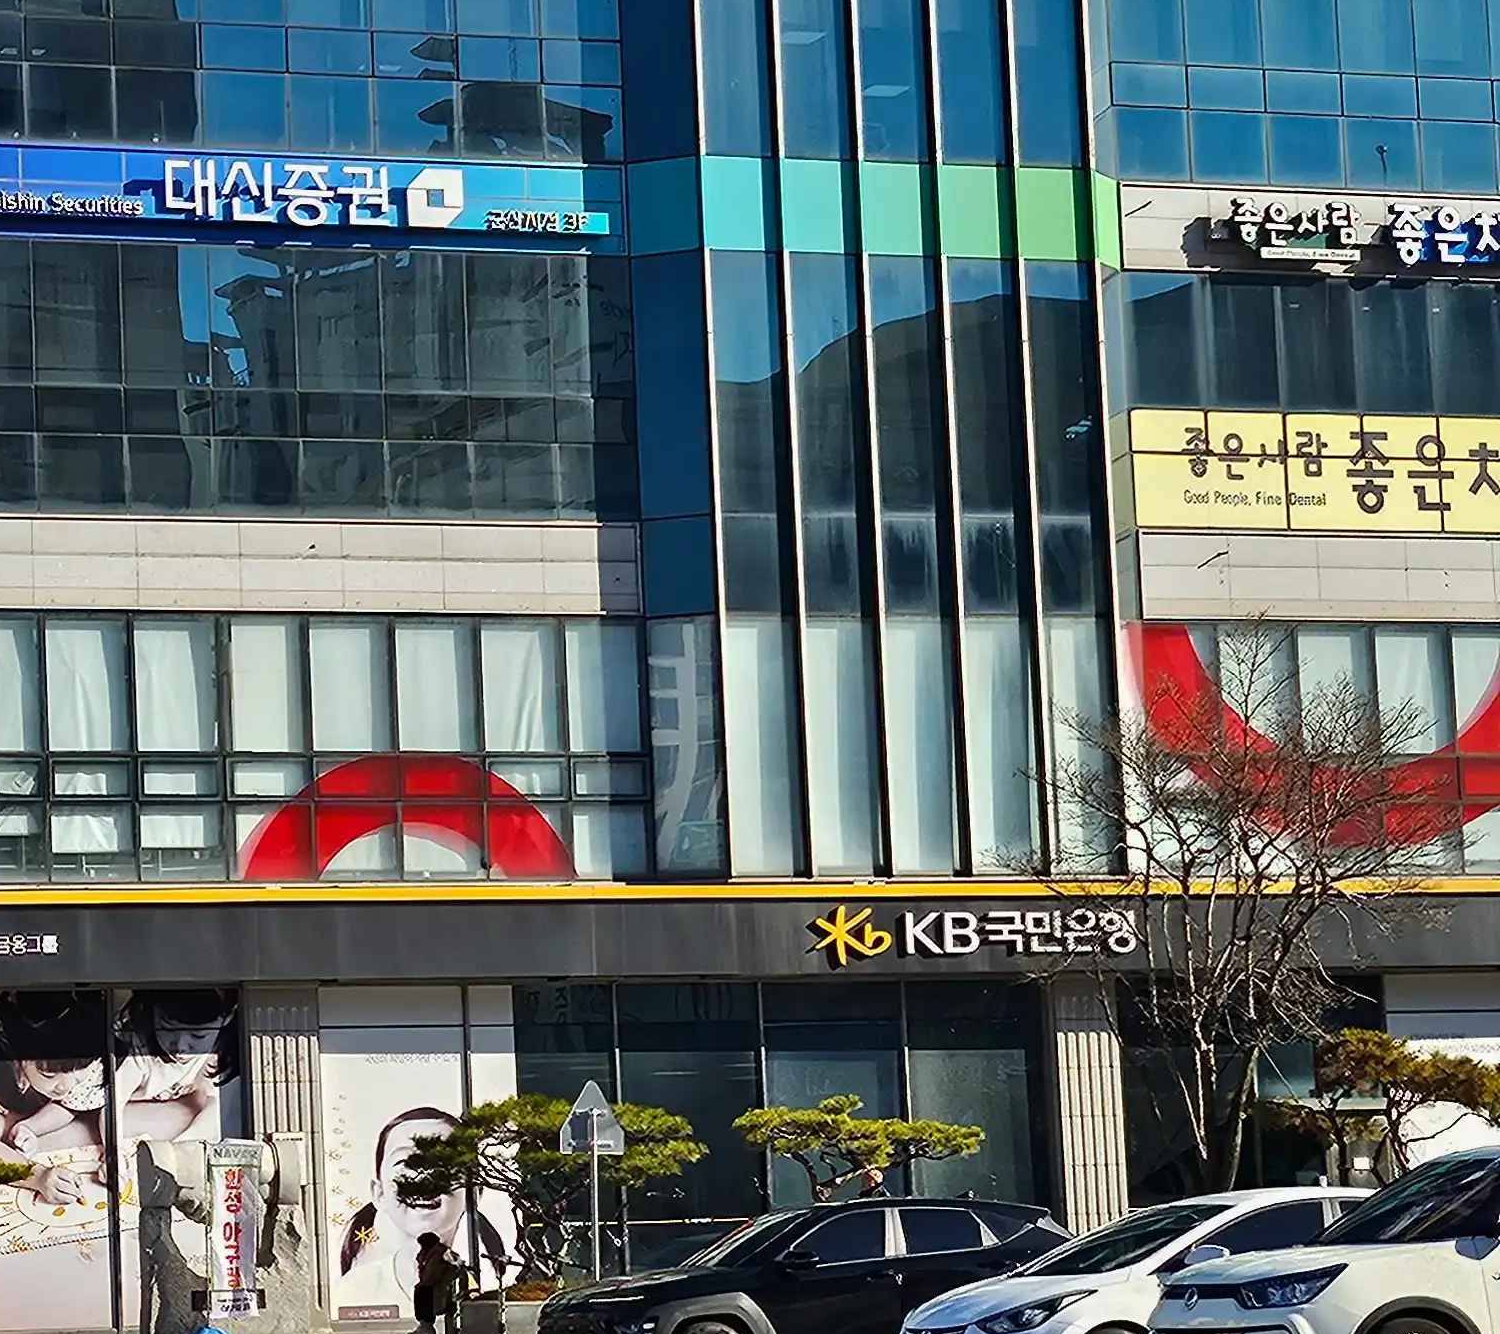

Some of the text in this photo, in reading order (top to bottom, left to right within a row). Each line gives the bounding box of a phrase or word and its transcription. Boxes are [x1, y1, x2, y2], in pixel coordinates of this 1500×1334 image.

[50, 192, 145, 216] Securities
[164, 157, 392, 228] 대신증권
[1232, 197, 1362, 246] 좋은사람
[1181, 427, 1329, 481] 좋은사람
[1183, 489, 1327, 508] Good People, Fine Dental
[904, 907, 1137, 955] KB국민은행
